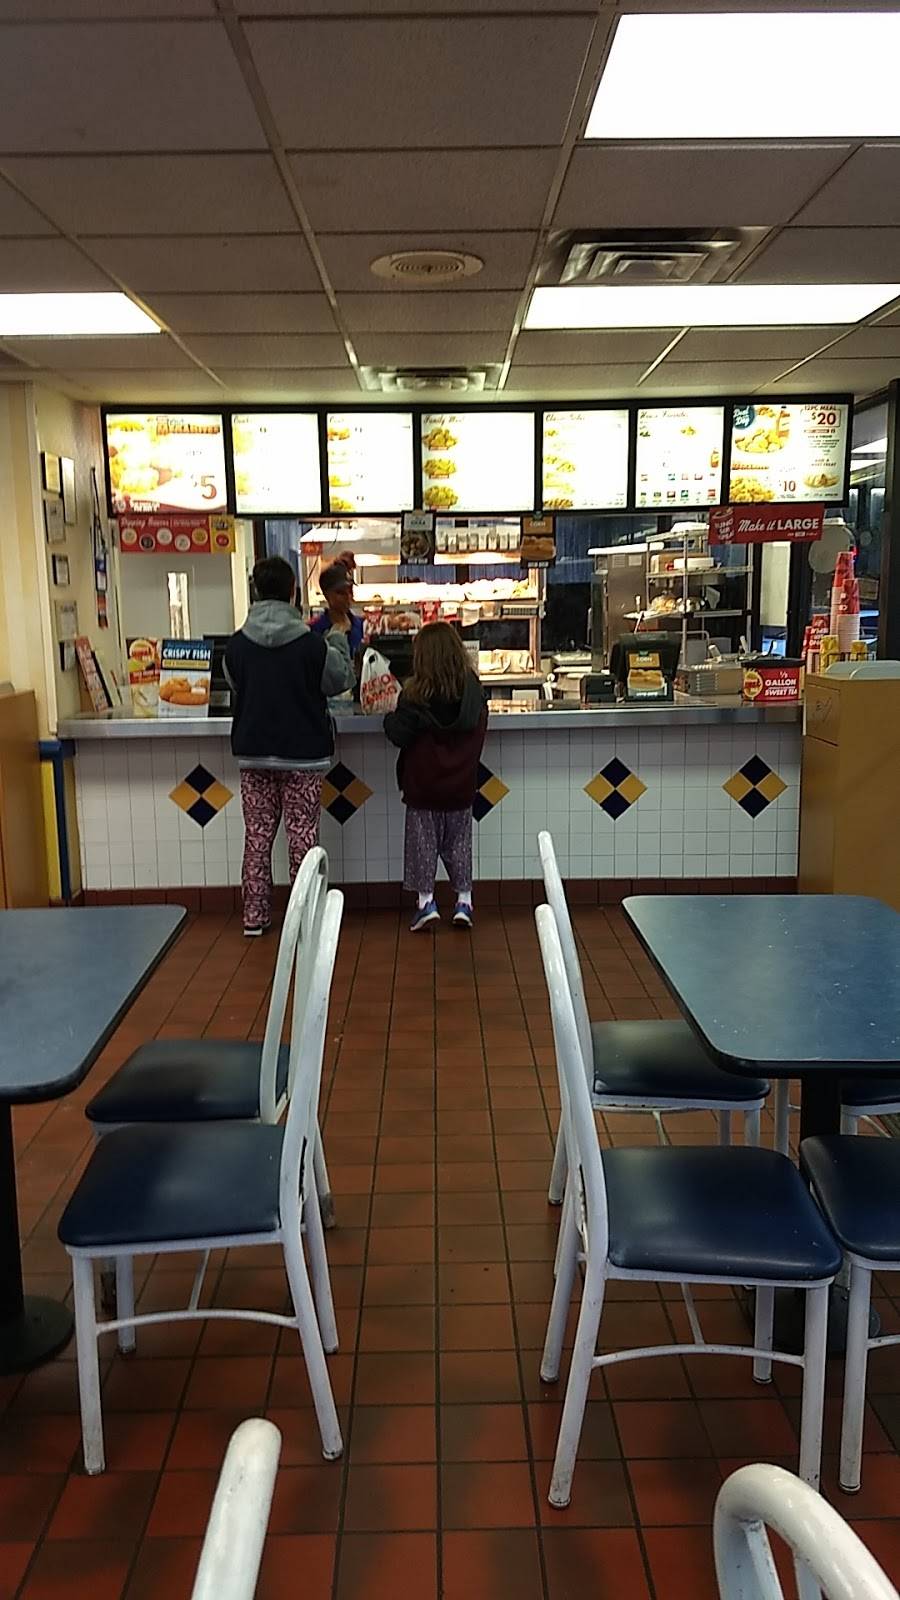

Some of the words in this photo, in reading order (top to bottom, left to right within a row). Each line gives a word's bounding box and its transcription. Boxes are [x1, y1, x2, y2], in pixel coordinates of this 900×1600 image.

[811, 412, 837, 425] $20
[738, 518, 765, 532] Make
[766, 519, 776, 531] it
[777, 518, 820, 530] LARGE
[163, 648, 191, 660] CRISPY
[192, 649, 211, 660] FISH
[765, 688, 788, 696] SWEET
[788, 688, 798, 696] TEA
